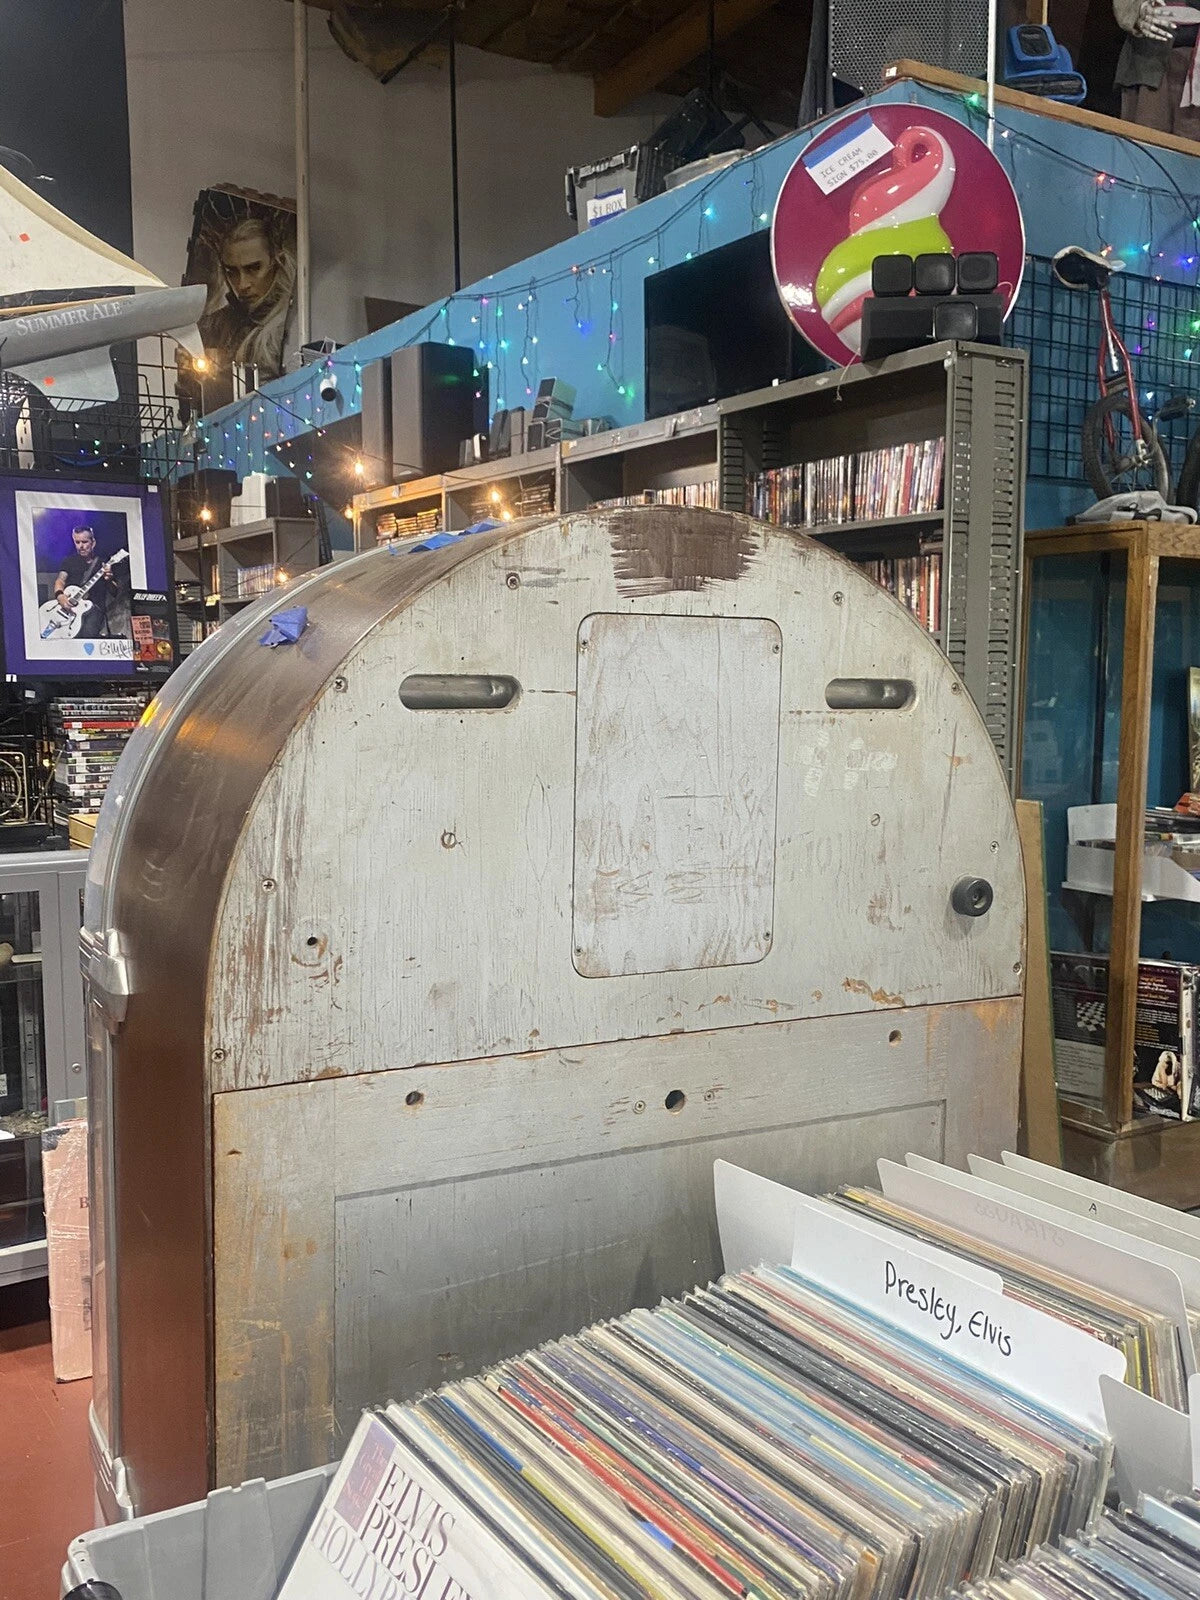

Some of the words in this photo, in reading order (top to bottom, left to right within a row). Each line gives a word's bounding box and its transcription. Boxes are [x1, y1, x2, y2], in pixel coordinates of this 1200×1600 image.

[820, 164, 837, 179] ICE
[837, 147, 863, 166] CREAM
[826, 170, 848, 187] SIGN
[848, 149, 879, 172] $75.00
[605, 200, 624, 214] BOX
[15, 306, 90, 336] SUMMER
[91, 301, 123, 320] ALE
[1088, 1202, 1098, 1215] A
[885, 1260, 962, 1340] Presley,
[968, 1310, 1012, 1356] Elvis
[377, 1462, 457, 1558] ELVIS
